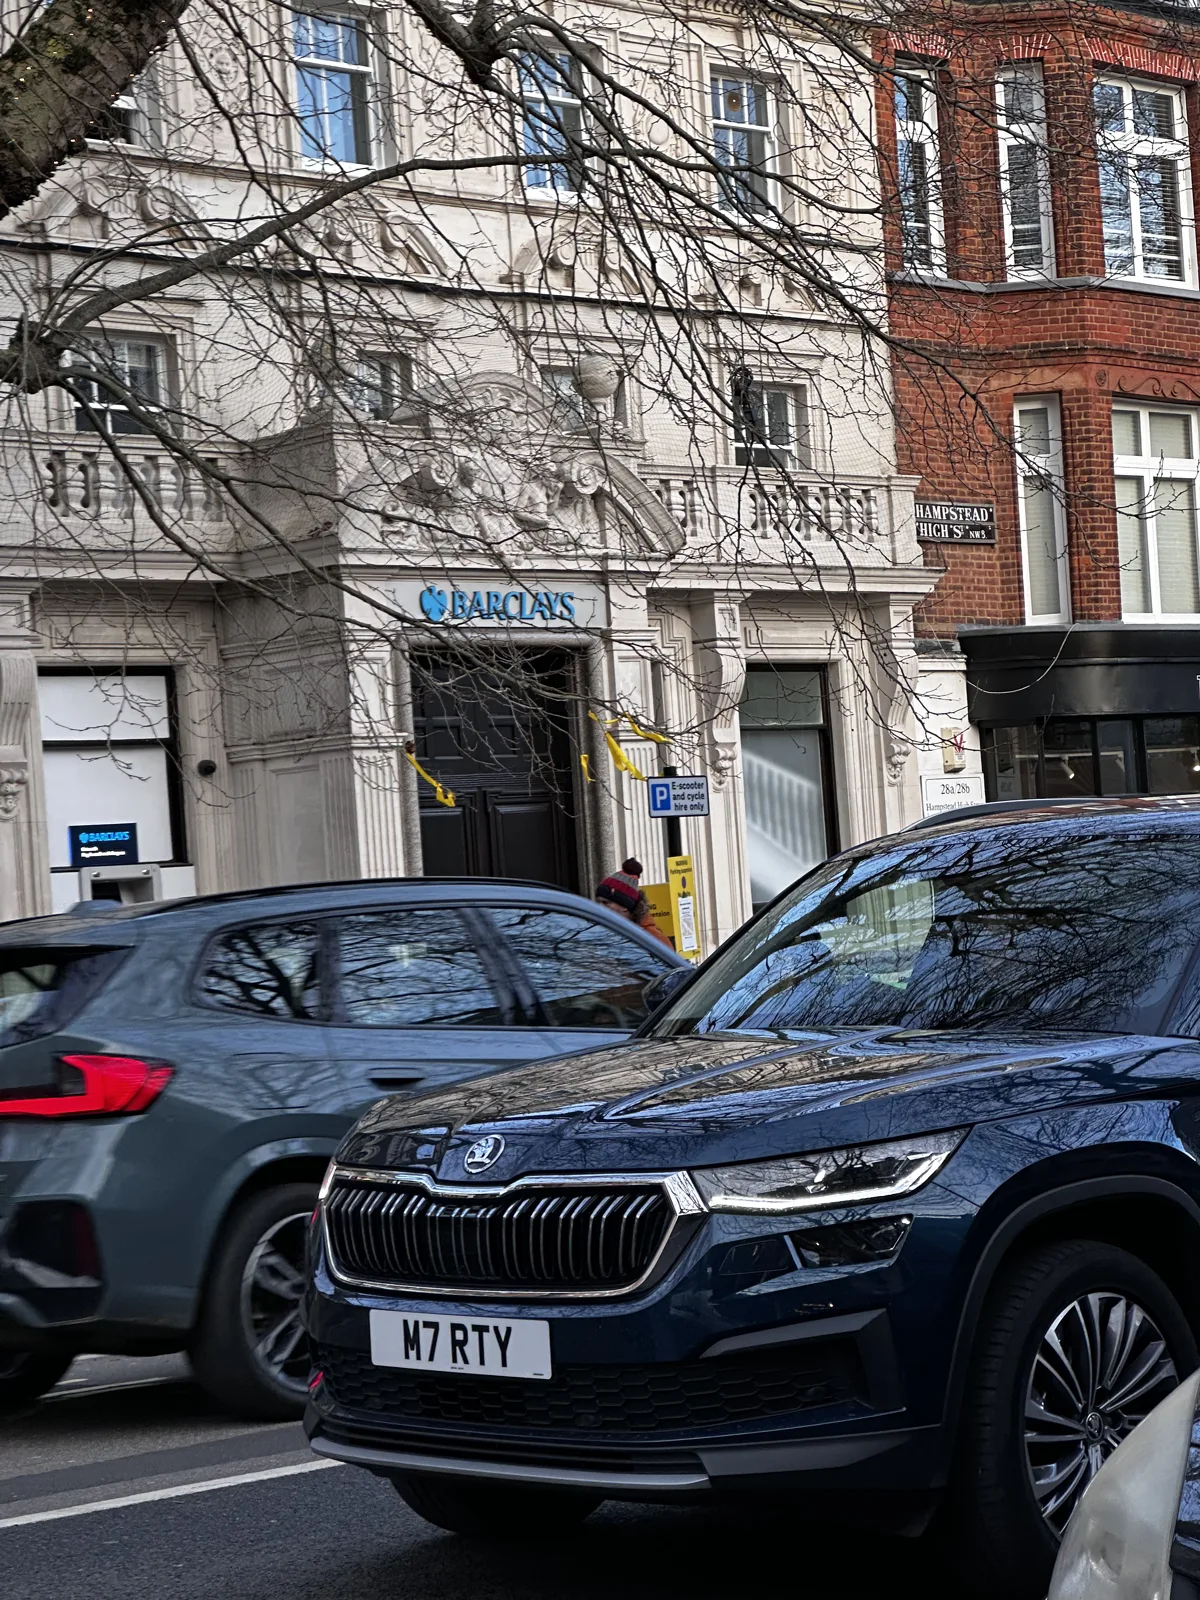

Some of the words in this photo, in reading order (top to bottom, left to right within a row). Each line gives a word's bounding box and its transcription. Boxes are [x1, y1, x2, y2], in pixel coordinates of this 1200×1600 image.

[915, 504, 989, 522] HAMPSTEAD
[920, 522, 949, 538] HIGH
[451, 590, 576, 620] BARCLAYS
[671, 781, 704, 790] E-scooter
[940, 782, 971, 795] 28a/28b
[655, 786, 668, 809] P
[672, 791, 686, 801] and
[686, 791, 705, 802] cycle
[674, 802, 688, 811] hire
[689, 802, 704, 812] only
[926, 801, 957, 811] Hampstead
[89, 831, 130, 842] BARCLAYS
[402, 1319, 440, 1362] M7
[450, 1322, 512, 1368] RTY
